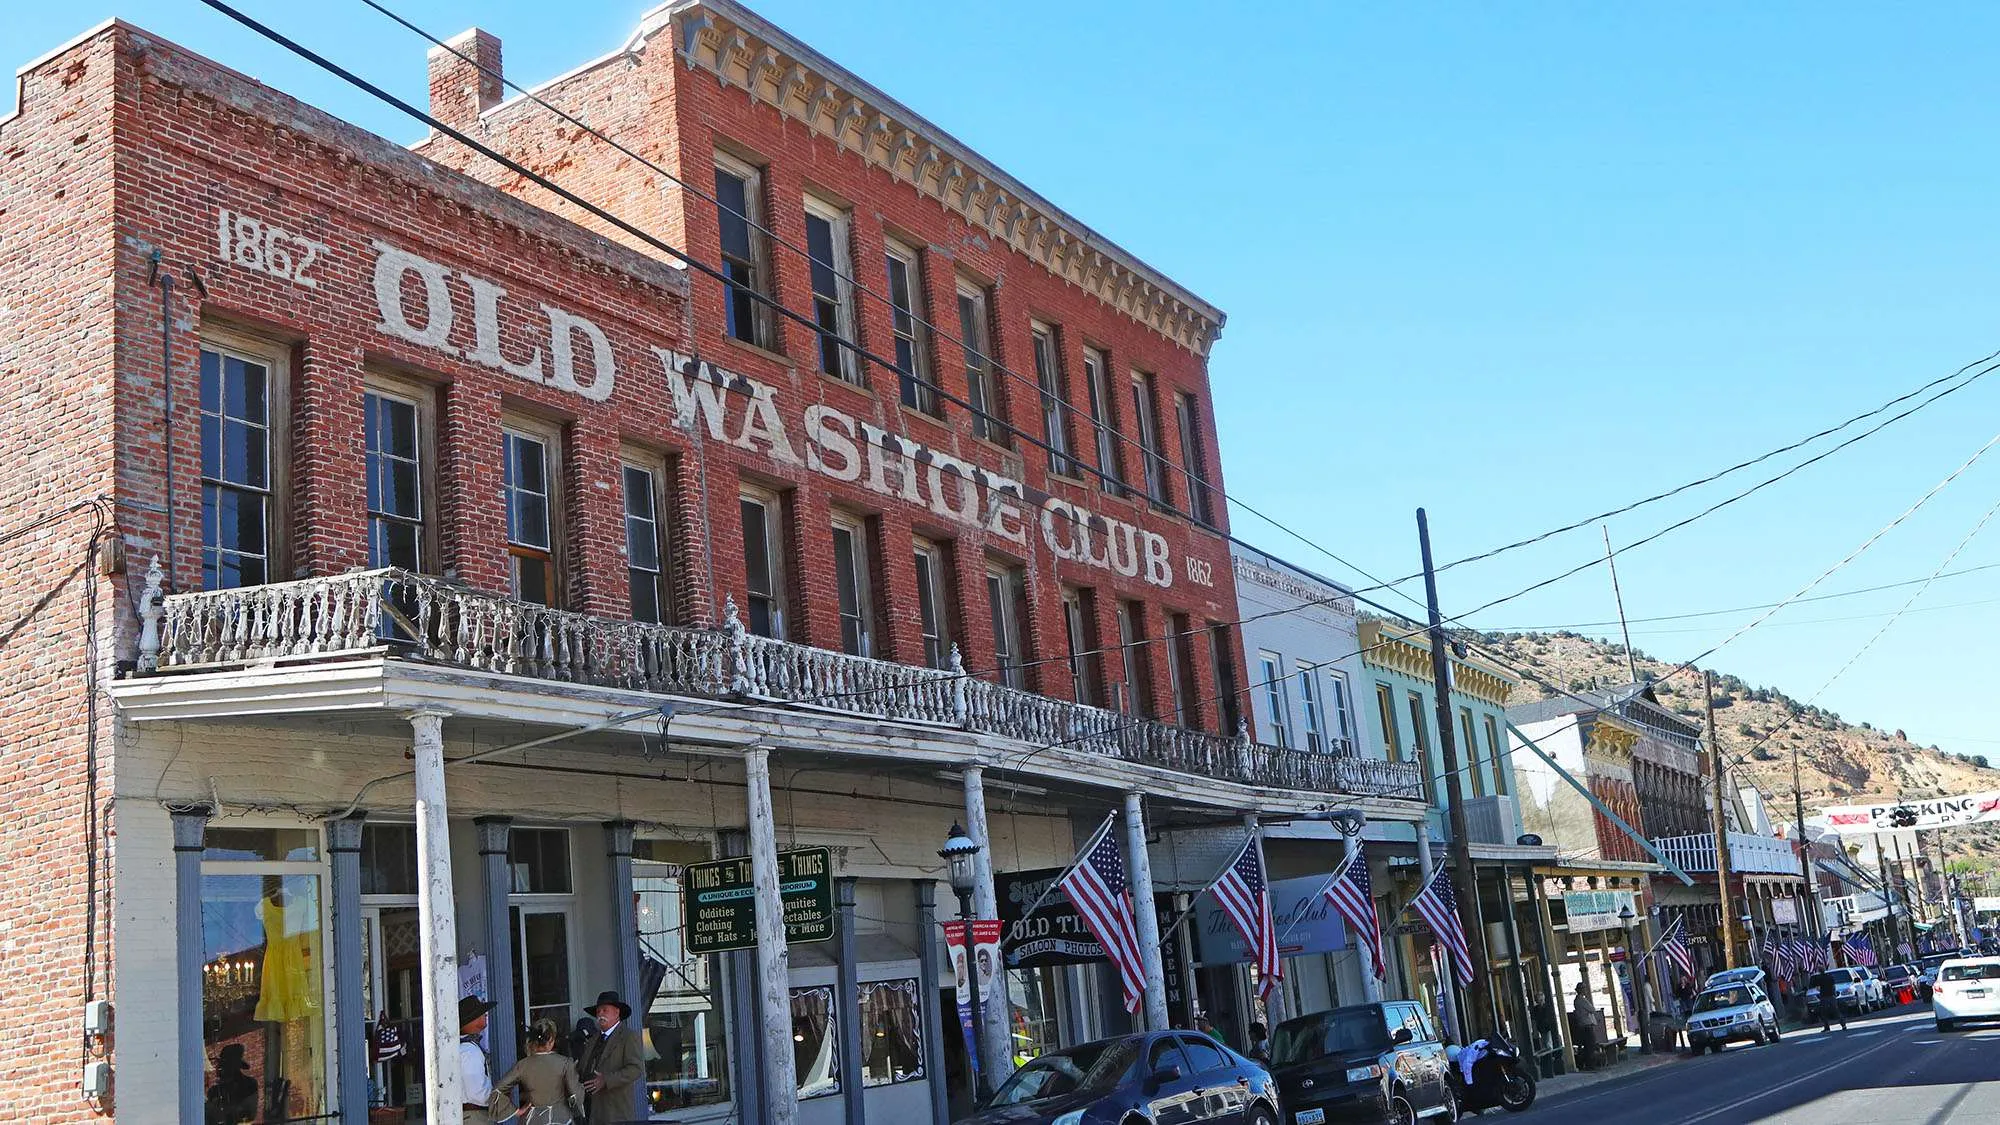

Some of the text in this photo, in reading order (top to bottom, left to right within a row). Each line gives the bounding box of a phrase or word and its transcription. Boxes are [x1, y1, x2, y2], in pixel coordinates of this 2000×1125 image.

[218, 209, 1214, 588] 1862 OLD WASHOE CLUB 1862
[690, 867, 721, 889] THINGS
[738, 861, 753, 884] THI
[791, 854, 824, 876] THINGS
[700, 906, 735, 919] Oddities
[783, 897, 817, 911] quities
[1292, 896, 1329, 924] Club
[696, 920, 732, 932] Clothing
[783, 909, 822, 923] ectables
[1012, 917, 1050, 940] OLD
[694, 934, 713, 945] Fine
[717, 931, 738, 943] Hats
[801, 923, 825, 934] More
[1020, 939, 1104, 958] SALOON PHOTOS
